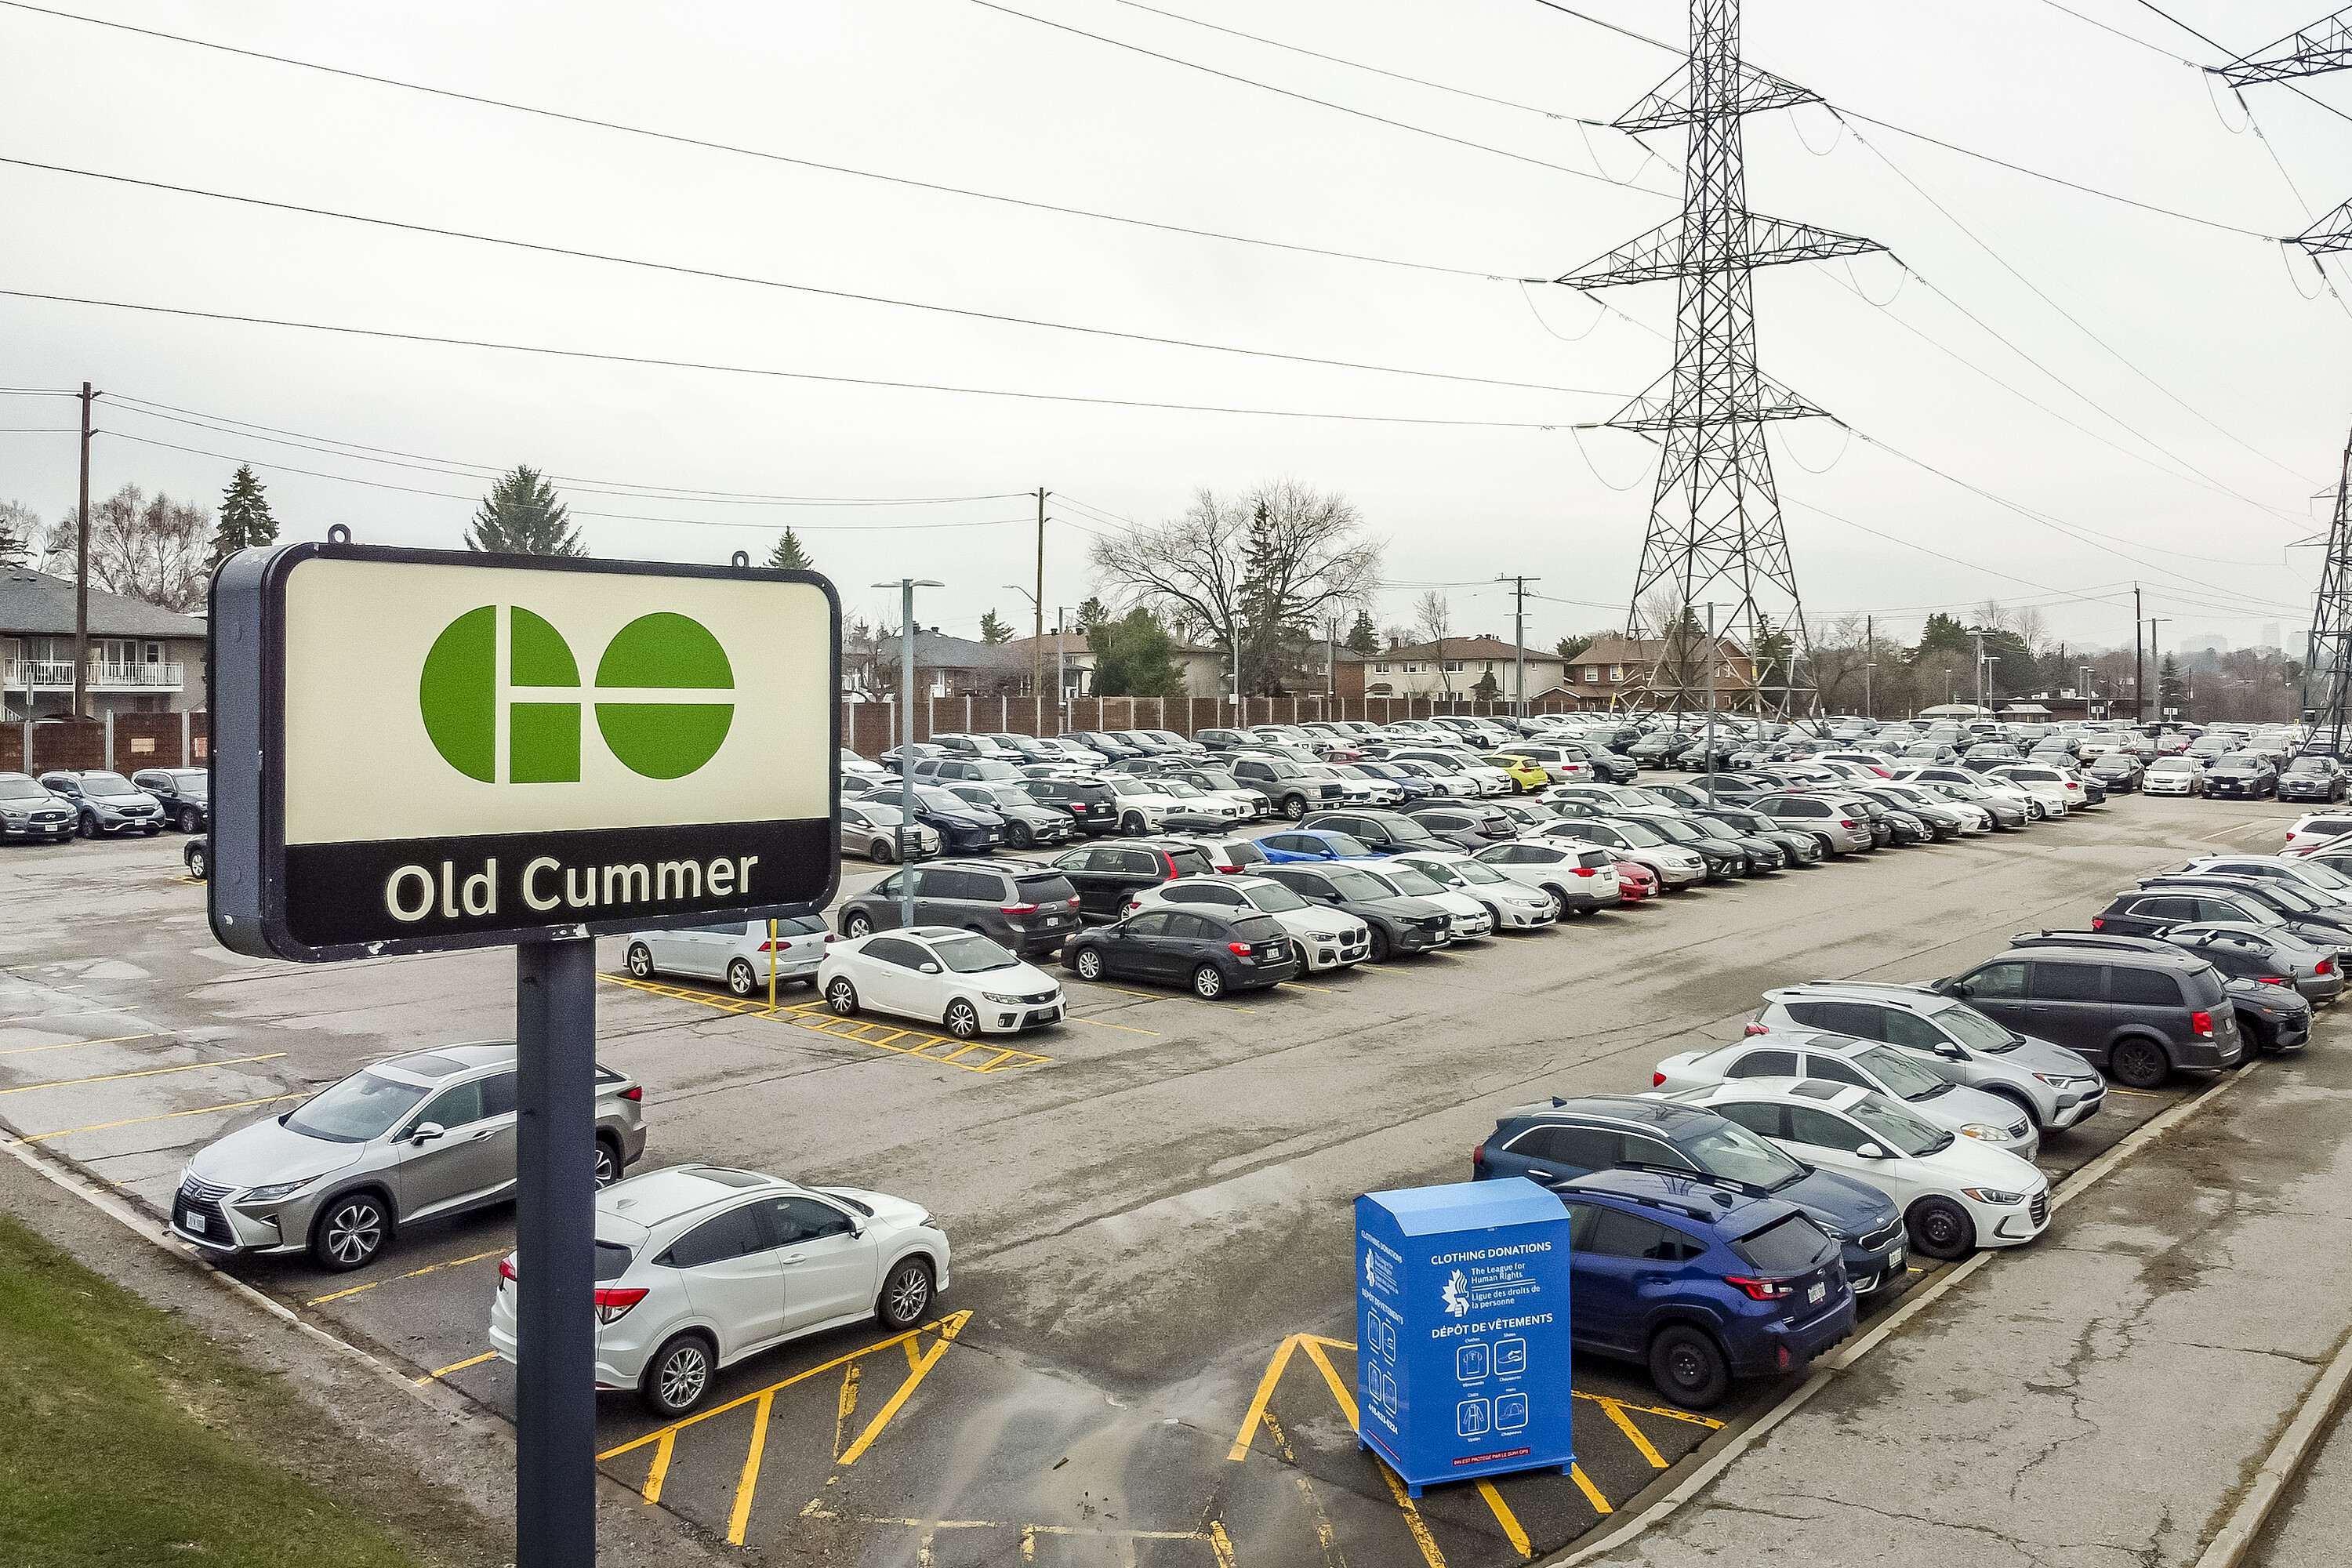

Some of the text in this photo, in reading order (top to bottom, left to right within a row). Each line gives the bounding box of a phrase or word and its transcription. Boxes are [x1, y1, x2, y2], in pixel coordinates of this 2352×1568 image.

[420, 605, 735, 783] GO
[387, 855, 758, 921] Old Cummer
[1431, 1241, 1552, 1265] CLOTHING DONATIONS
[1471, 1267, 1485, 1276] The
[1486, 1265, 1513, 1273] League
[1472, 1271, 1523, 1284] Human Rights
[1472, 1292, 1492, 1301] Ligue
[1508, 1287, 1530, 1296] droits
[1480, 1298, 1515, 1308] personne
[1432, 1313, 1553, 1338] DÉPÔT DE VÊTEMENTS
